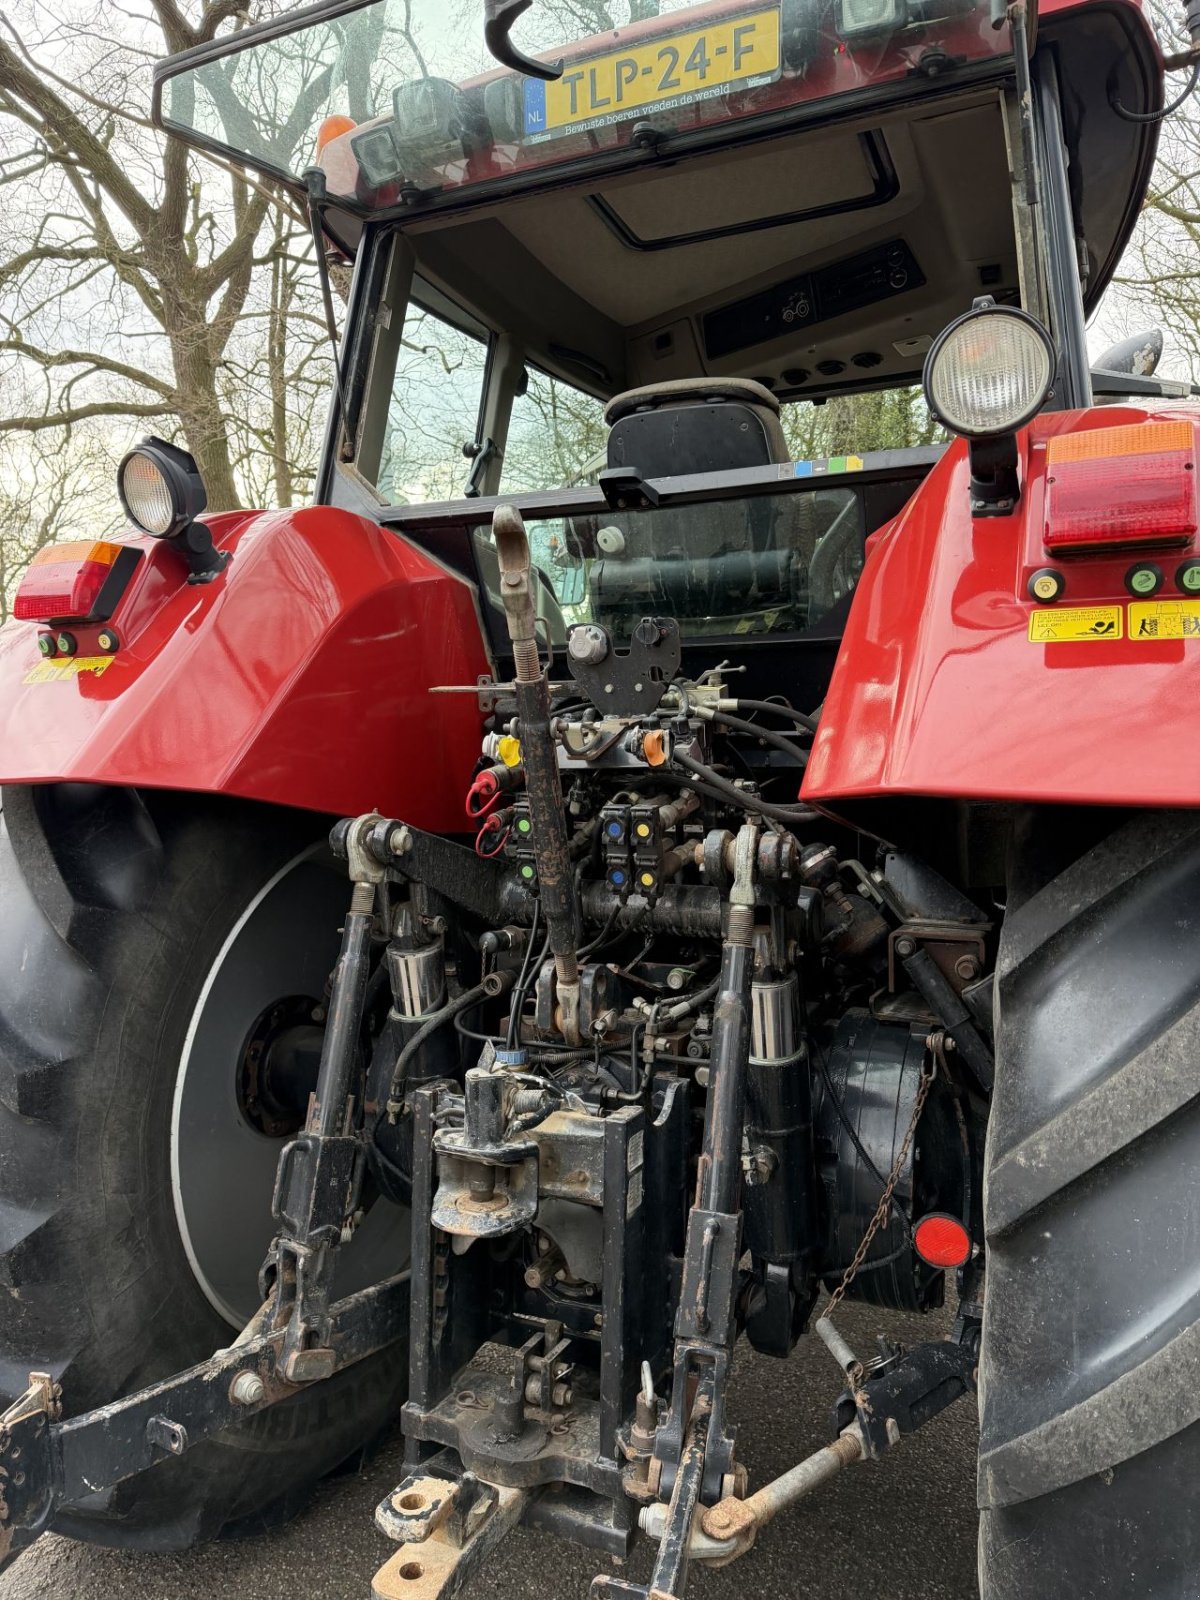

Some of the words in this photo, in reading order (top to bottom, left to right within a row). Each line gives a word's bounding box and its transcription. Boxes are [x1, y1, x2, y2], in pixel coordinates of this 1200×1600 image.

[562, 23, 756, 115] TLP-24-F
[528, 110, 543, 124] NL
[565, 117, 605, 135] Bewuste
[606, 108, 641, 126] boeren
[642, 97, 678, 115] voeden
[679, 94, 693, 104] de
[695, 83, 730, 102] wereld
